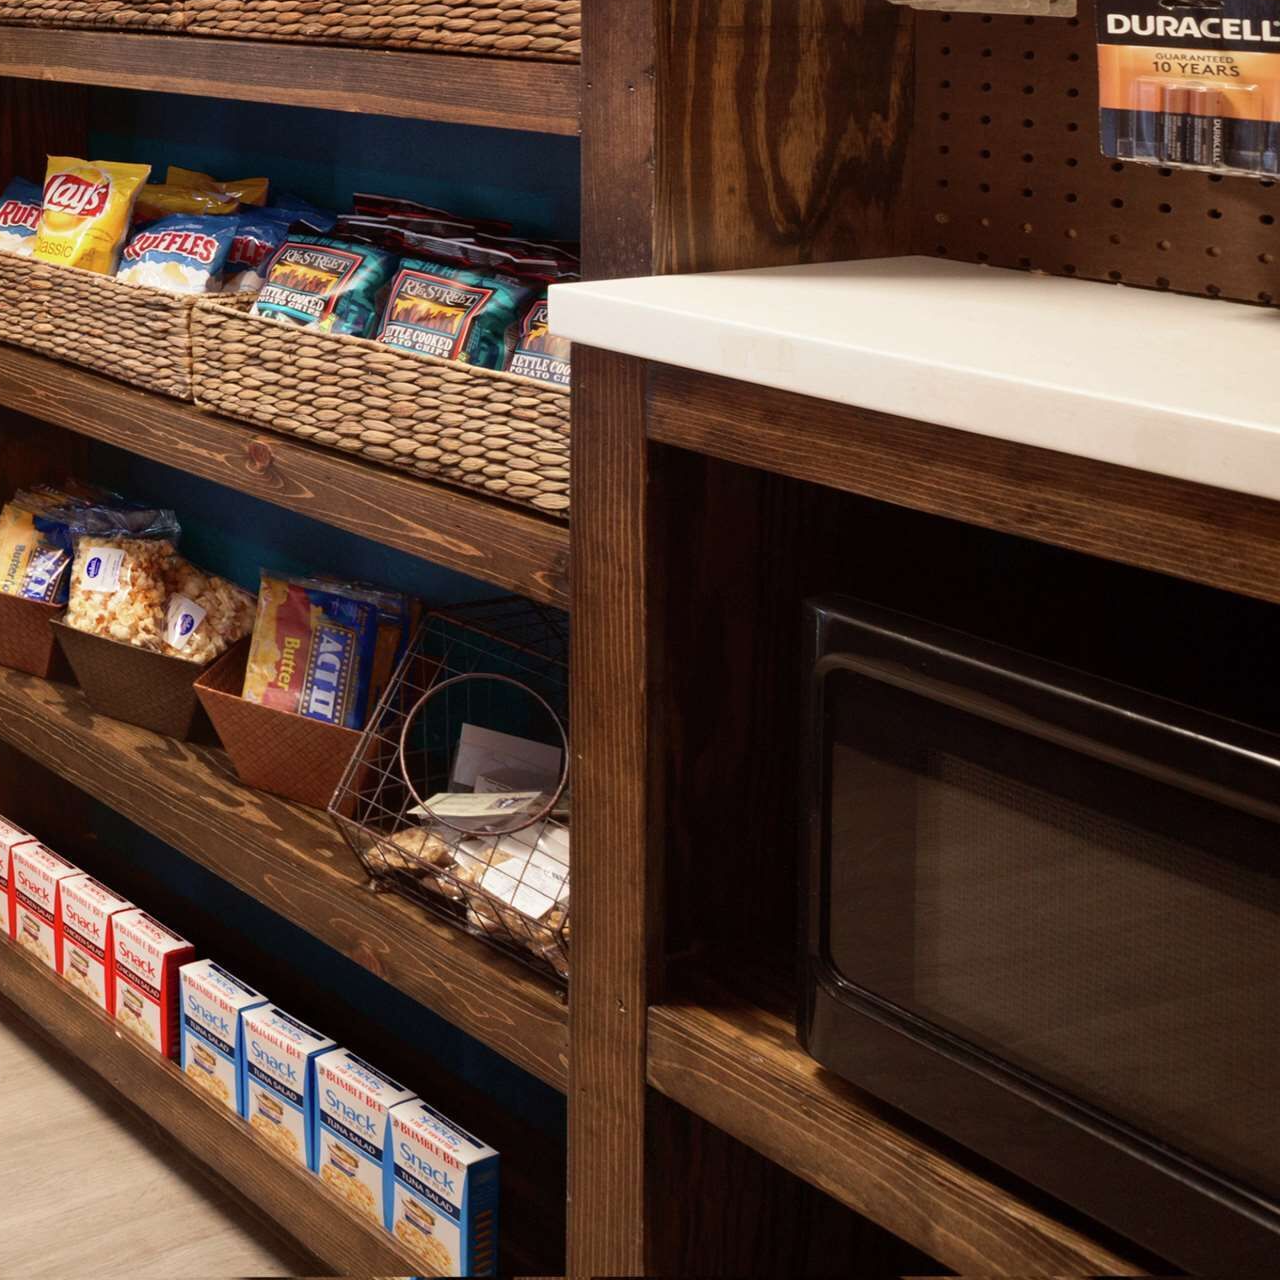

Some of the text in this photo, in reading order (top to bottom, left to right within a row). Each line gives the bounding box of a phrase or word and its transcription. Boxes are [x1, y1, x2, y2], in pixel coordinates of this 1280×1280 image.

[1106, 13, 1280, 42] DURACELL
[1153, 61, 1241, 78] 10 YEARS
[1155, 52, 1234, 65] GUARANTEED
[1213, 118, 1224, 163] DURACELL
[43, 174, 111, 216] Lay's
[124, 230, 219, 264] RUFFLES
[285, 292, 325, 312] COOKED
[425, 284, 477, 307] STREET
[413, 332, 453, 351] COOKED
[414, 345, 449, 359] CHIPS
[510, 365, 558, 382] POTATO
[512, 353, 550, 373] KETTLE
[277, 636, 301, 692] Butter
[318, 634, 344, 689] ACT
[18, 870, 50, 903] Snack
[65, 903, 101, 938] Snack
[119, 940, 157, 978] Snack
[188, 994, 229, 1036] Snack
[189, 1020, 230, 1054] TUNA SALAD
[251, 1040, 297, 1082] Snack
[252, 1066, 298, 1102] TUNA SALAD
[325, 1088, 376, 1134] Snack
[326, 1116, 377, 1156] TUNA SALAD
[399, 1142, 456, 1194] Snack
[400, 1169, 454, 1215] TUNA SALAD
